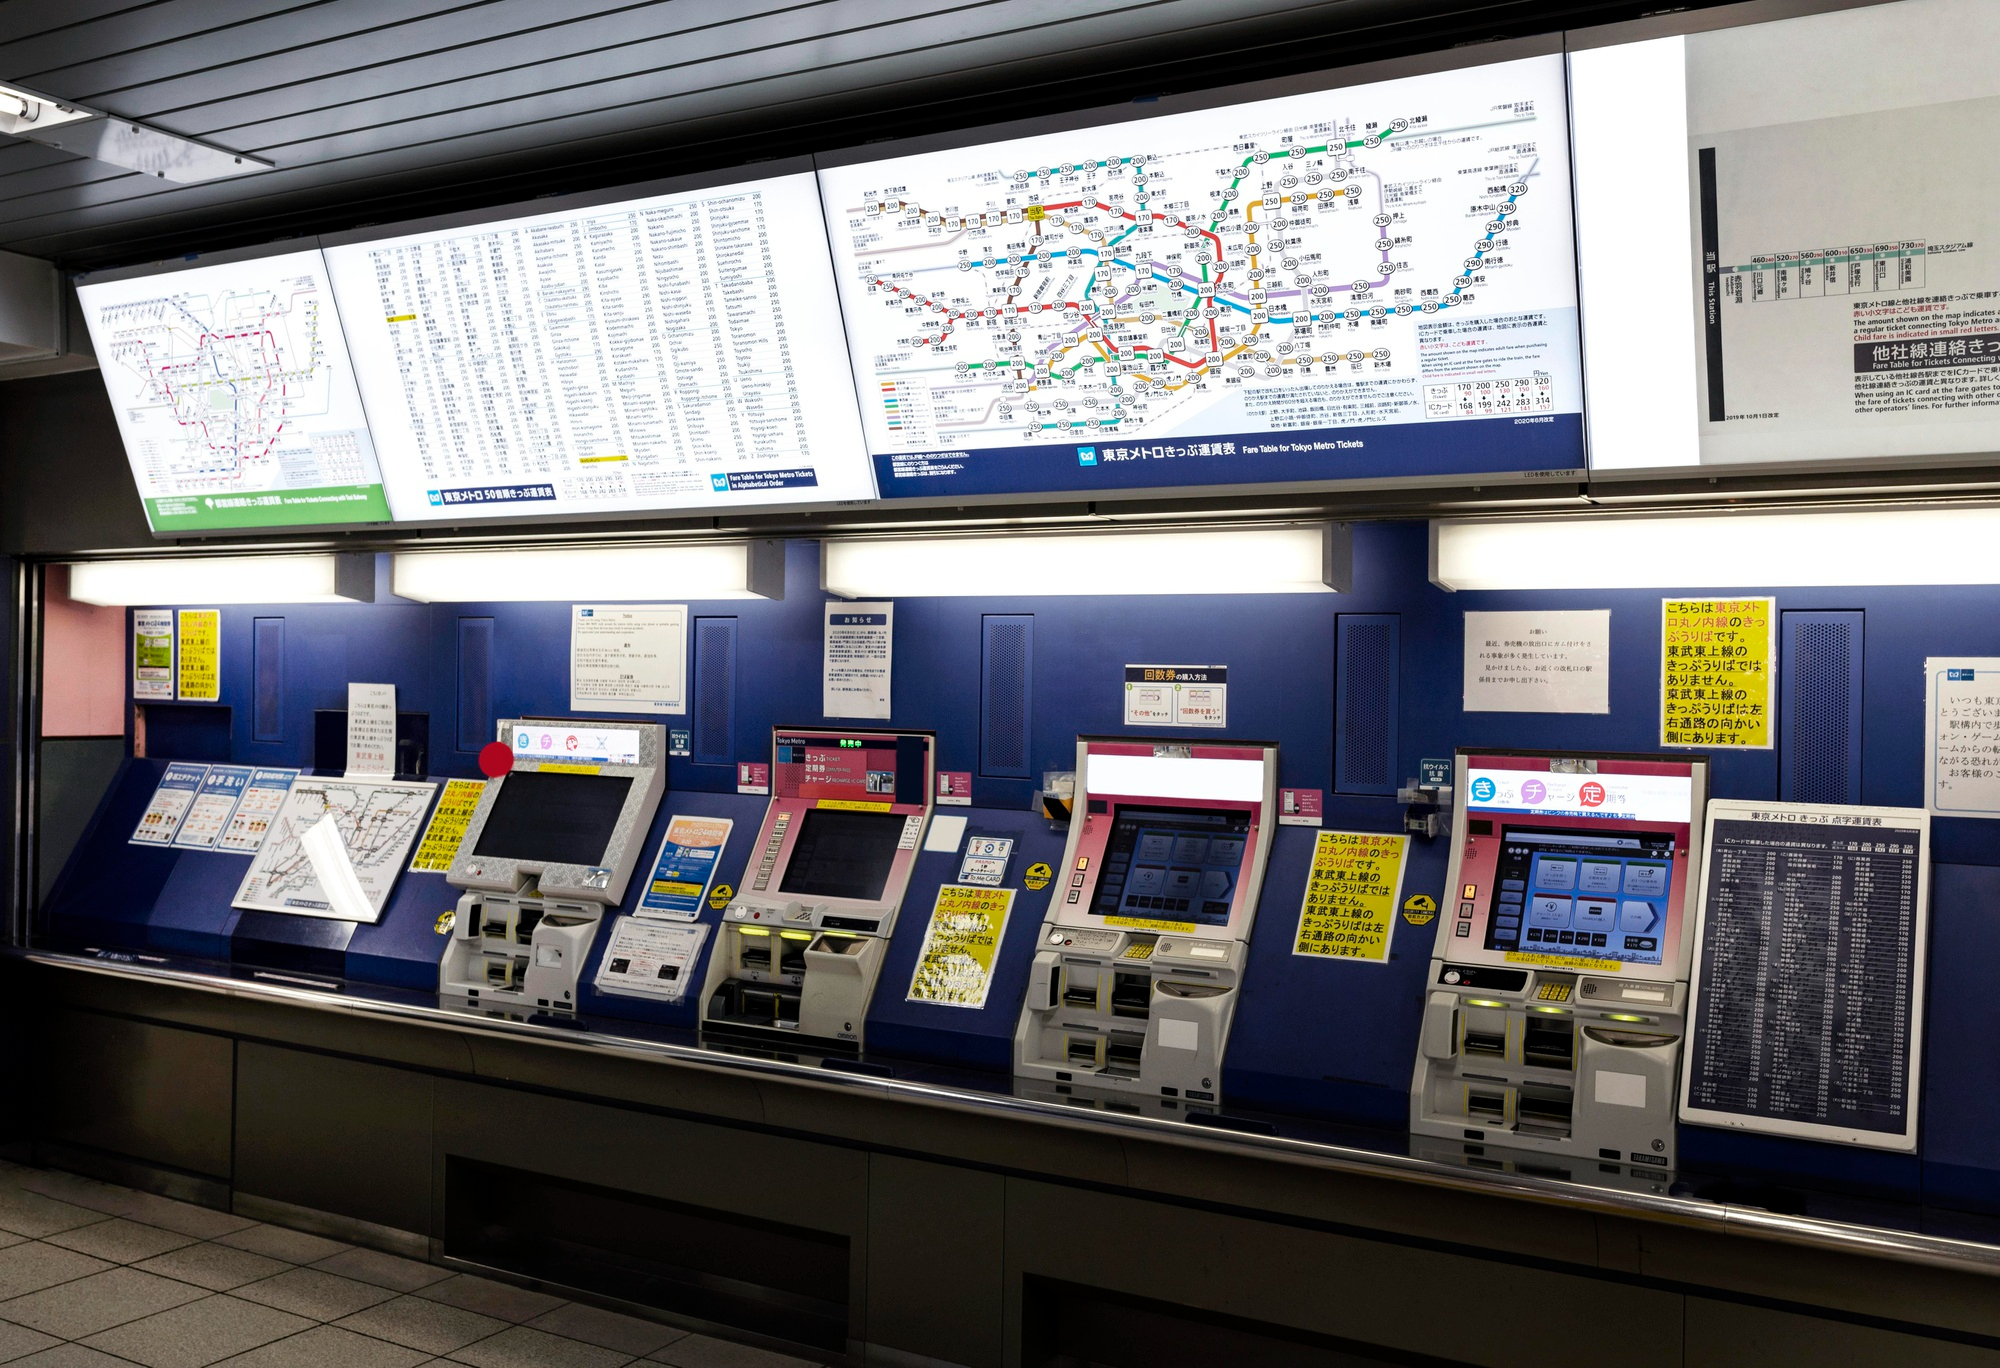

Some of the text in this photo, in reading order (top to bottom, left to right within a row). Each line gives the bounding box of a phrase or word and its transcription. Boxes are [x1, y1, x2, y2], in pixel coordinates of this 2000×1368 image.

[1339, 124, 1356, 133] 北千住
[1392, 121, 1405, 129] 290
[1261, 182, 1272, 190] 上野
[1510, 185, 1525, 193] 320
[1029, 208, 1041, 216] 当駅
[1136, 252, 1152, 260] 九段下
[1706, 251, 1716, 273] 当駅
[1854, 304, 1949, 318] 赤い小文字はこども運賃です。
[1868, 318, 1894, 326] amount
[1908, 321, 1946, 330] connecting
[1948, 320, 1969, 328] Tokyo
[1897, 330, 1929, 338] indicated
[1940, 327, 1958, 335] small
[1960, 326, 1972, 334] red
[1873, 362, 1888, 370] Fare
[1890, 361, 1909, 369] Table
[1925, 358, 1951, 366] Tickets
[1953, 355, 1995, 364] Connecting
[1429, 403, 1452, 411] ICカード
[1102, 440, 1363, 461] 東京メトロきっぷ運賃表 Fare Table for Tokyo Metro Tickets
[764, 472, 778, 480] Tokyo
[738, 480, 768, 489] Alphabetical
[443, 490, 483, 503] 東京メトロ
[1668, 602, 1760, 613] こちらは東京メト
[1668, 617, 1765, 628] ロ丸ノ内線のきっ
[1668, 631, 1745, 643] ぷうりばです。
[1668, 646, 1748, 657] 東武東上線の
[1667, 660, 1761, 671] きっぷうりばでは
[1145, 669, 1207, 681] 回数券の購入方法
[1667, 675, 1734, 686] ありません。
[1667, 689, 1746, 700] 東武東上線の
[1666, 703, 1762, 715] きっぷうりばは左
[1666, 717, 1760, 729] 右通路の向かい
[840, 739, 862, 748] 発売中
[1666, 731, 1746, 744] 側にあります。
[805, 754, 826, 762] きっぷ
[805, 775, 832, 783] チャージ
[1938, 780, 1952, 790] す。
[1751, 812, 1882, 827] 東京メトロ きっぷ 点字運賃表
[1320, 834, 1397, 846] こちらは東京メト
[1318, 846, 1400, 858] ロ丸ノ内線のきっ
[1316, 858, 1380, 870] ぷうりばです。
[1313, 869, 1380, 883] 東武東上線の
[942, 887, 1004, 899] こちらは東京メト
[1311, 881, 1390, 895] きっぷうりばでは
[939, 899, 1005, 911] ロ丸ノ内線のきっ
[1308, 893, 1365, 907] ありません。
[1306, 905, 1373, 919] 東武東上線の
[1303, 918, 1384, 933] きっぷうりばは左
[1301, 930, 1380, 944] 右通路の向かい
[1298, 942, 1366, 957] 側にあります。
